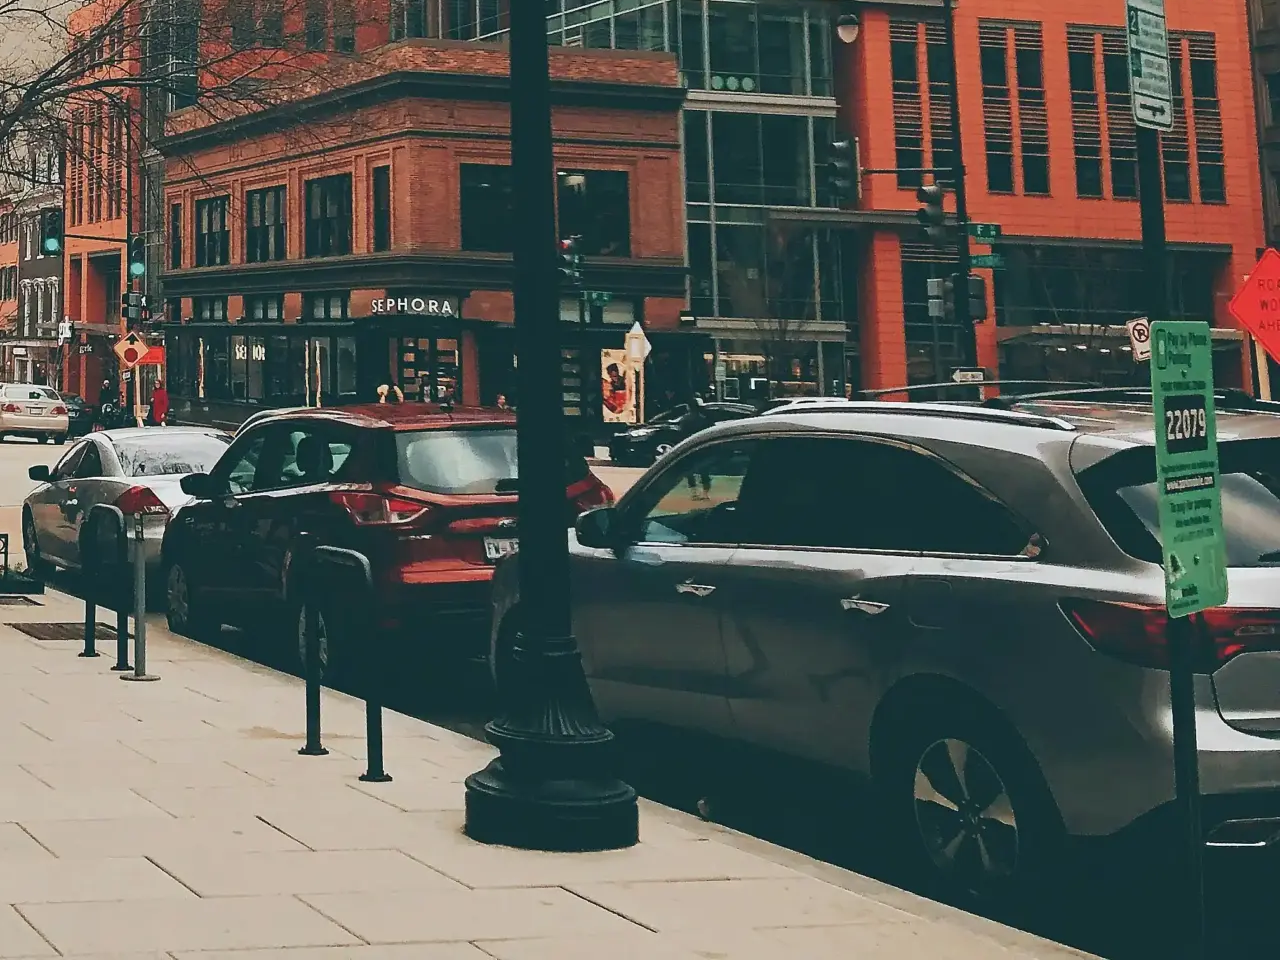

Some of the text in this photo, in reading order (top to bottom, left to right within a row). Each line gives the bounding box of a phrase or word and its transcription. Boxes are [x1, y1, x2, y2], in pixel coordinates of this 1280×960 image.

[371, 298, 453, 314] SEPHORA
[1261, 299, 1280, 312] WO
[1166, 408, 1207, 440] 22079
